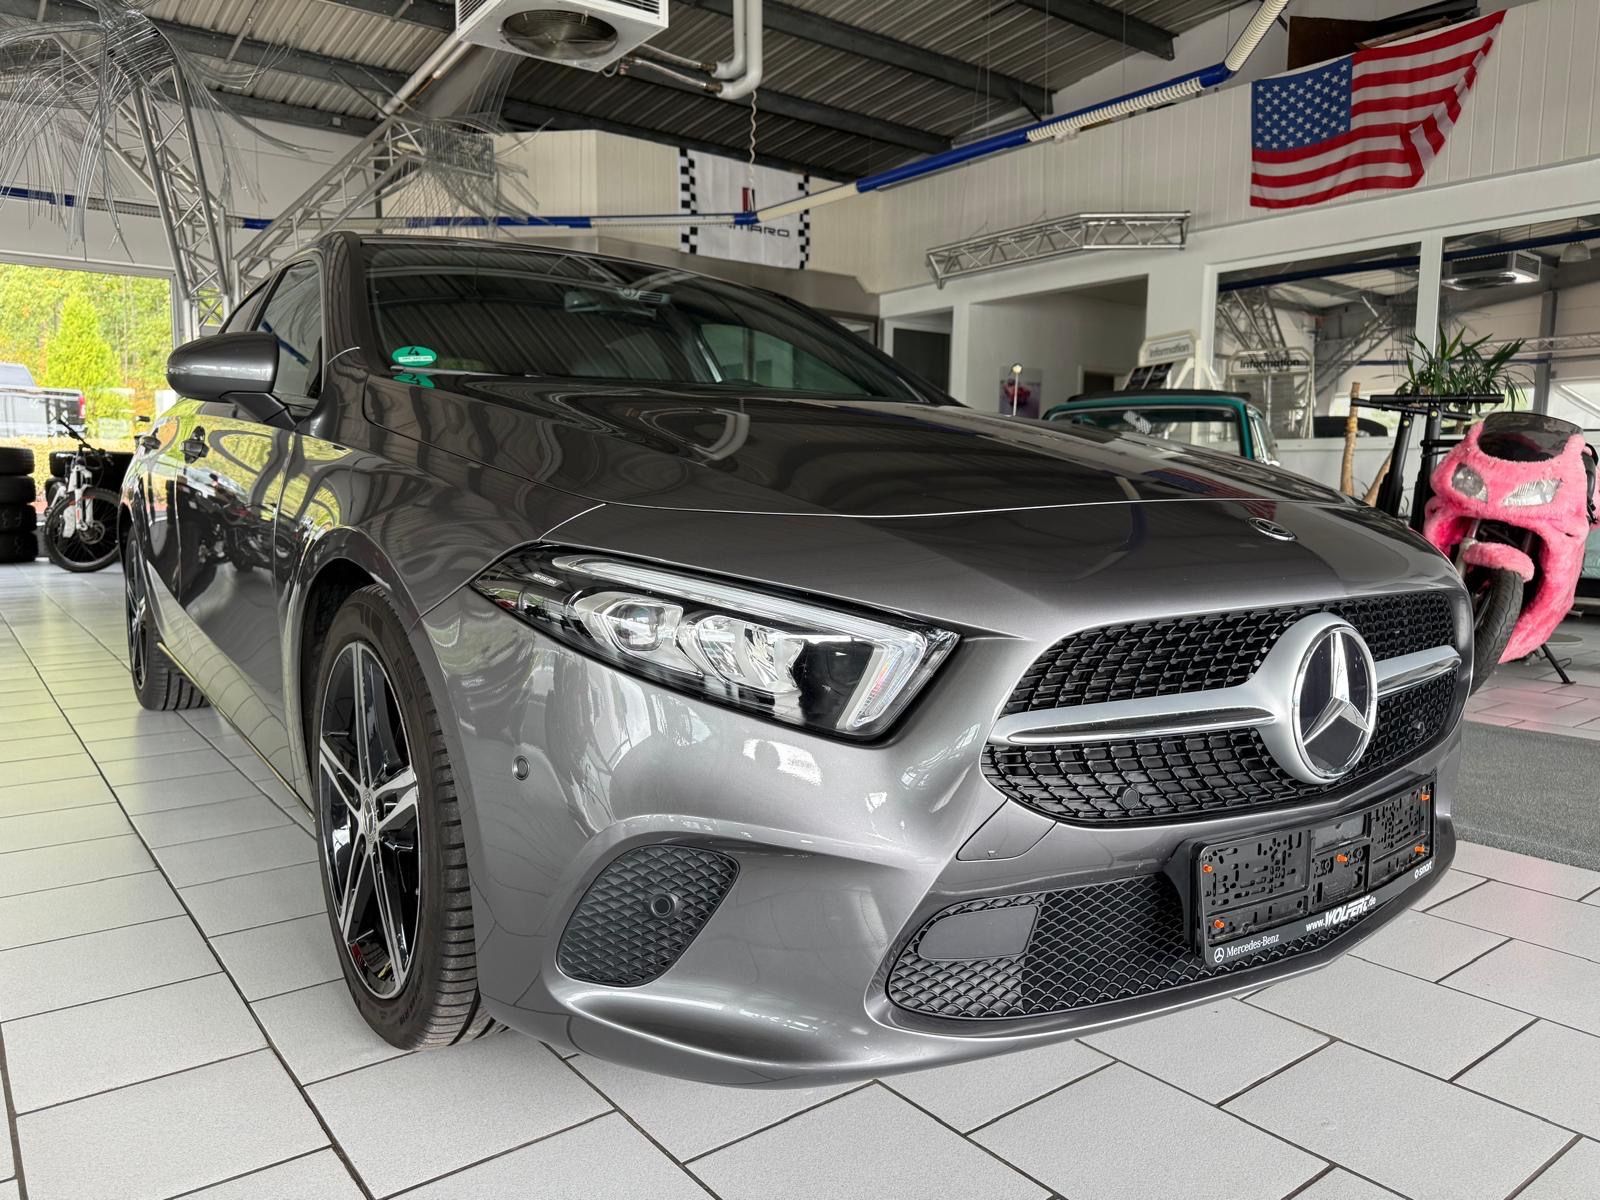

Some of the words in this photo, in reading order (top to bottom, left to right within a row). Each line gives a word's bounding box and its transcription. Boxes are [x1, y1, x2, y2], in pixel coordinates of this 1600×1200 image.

[407, 346, 420, 356] 4
[1149, 342, 1190, 358] Information
[1240, 358, 1300, 369] Information
[1226, 934, 1280, 957] Mercedes-Benz
